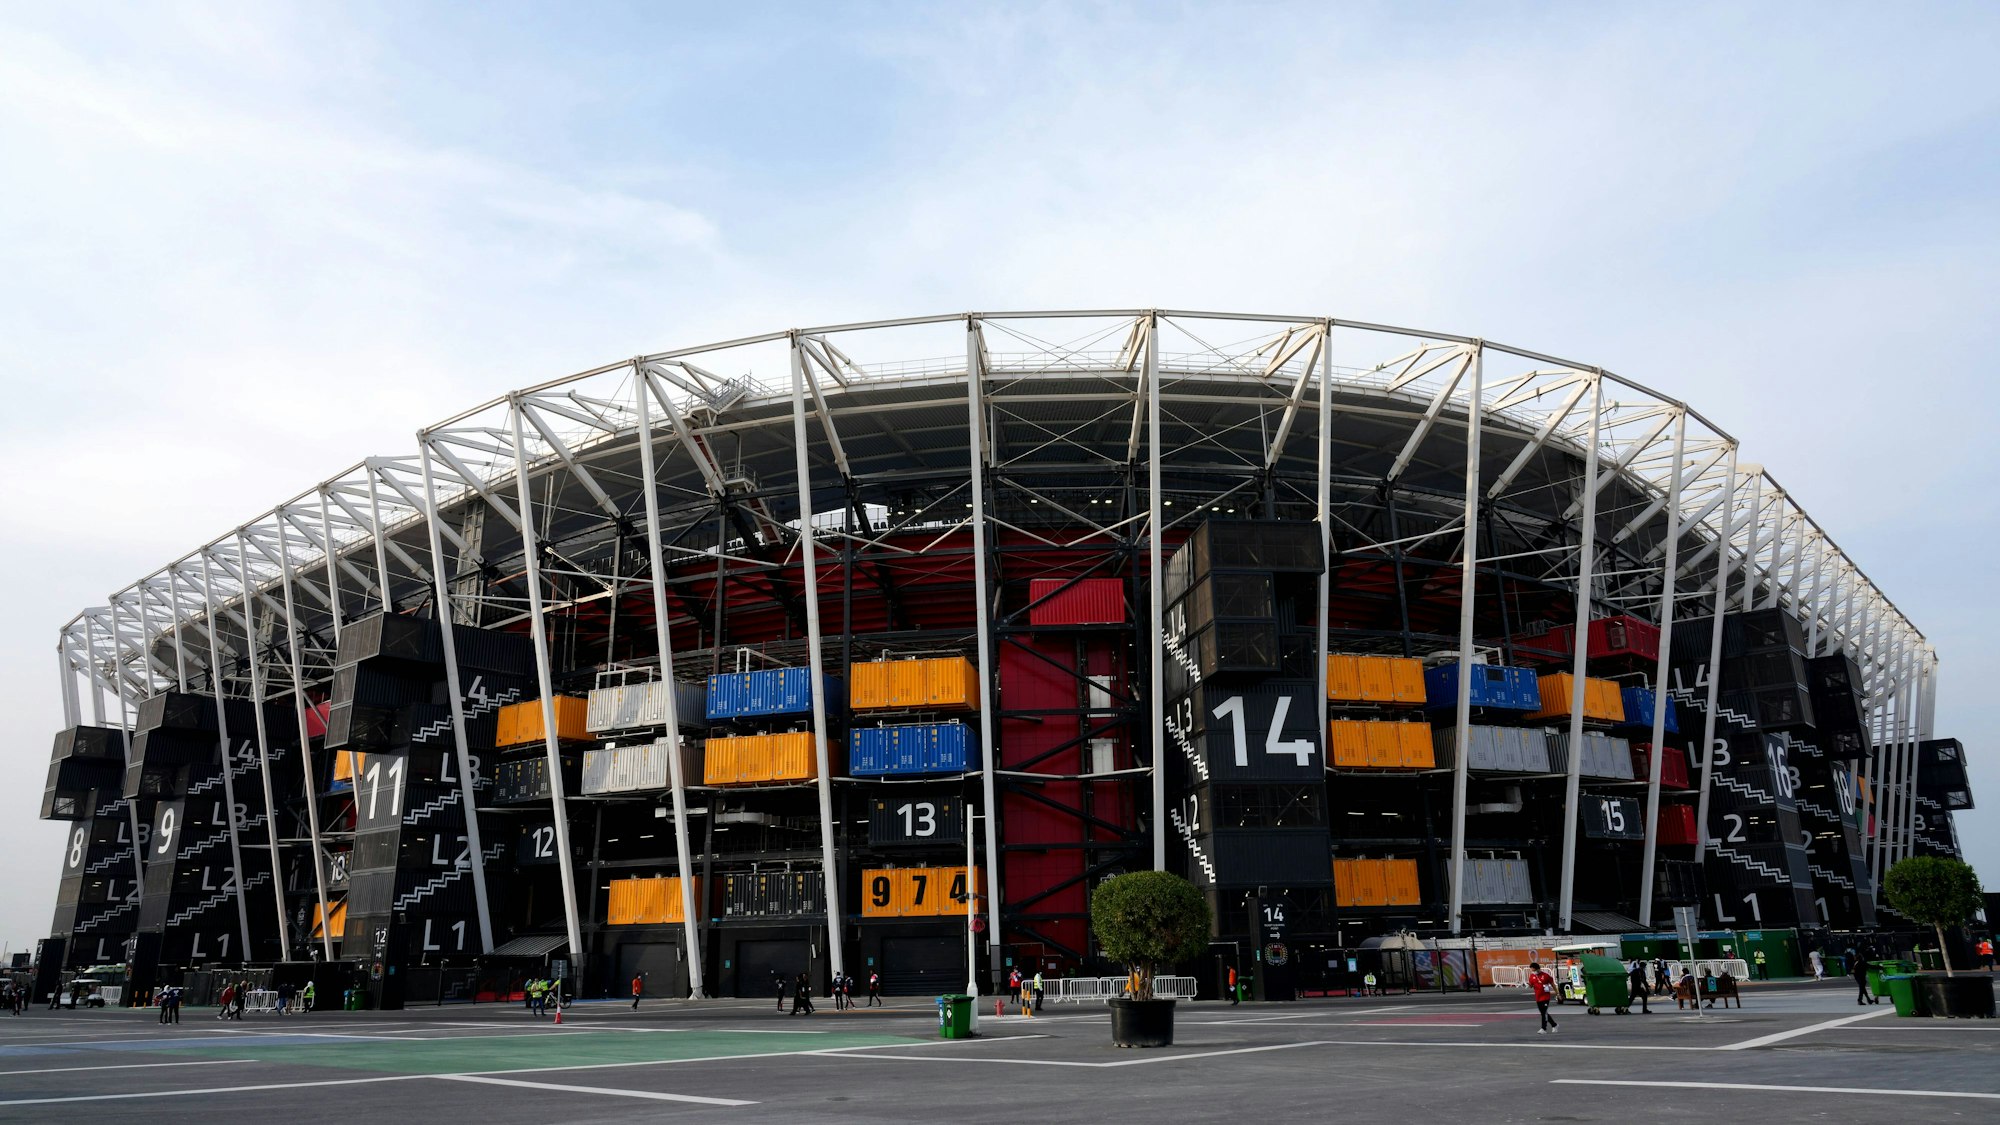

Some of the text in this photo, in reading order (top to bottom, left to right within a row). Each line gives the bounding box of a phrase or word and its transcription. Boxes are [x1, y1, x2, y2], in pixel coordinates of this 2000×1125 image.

[461, 676, 488, 704] 4
[1212, 696, 1316, 767] 14
[440, 752, 481, 784] L3
[1688, 738, 1731, 768] L3
[1768, 743, 1792, 799] 16
[366, 757, 404, 820] 11
[1833, 769, 1854, 815] 18
[157, 807, 175, 854] 9
[212, 802, 248, 829] L3
[896, 802, 937, 837] 13
[1601, 800, 1625, 831] 15
[70, 827, 85, 868] 8
[117, 821, 151, 844] L3
[532, 826, 555, 858] 12
[431, 833, 473, 866] L2
[202, 866, 237, 891] L2
[330, 855, 346, 884] 10
[107, 879, 140, 901] L2
[1263, 907, 1285, 922] 14
[375, 930, 387, 943] 12
